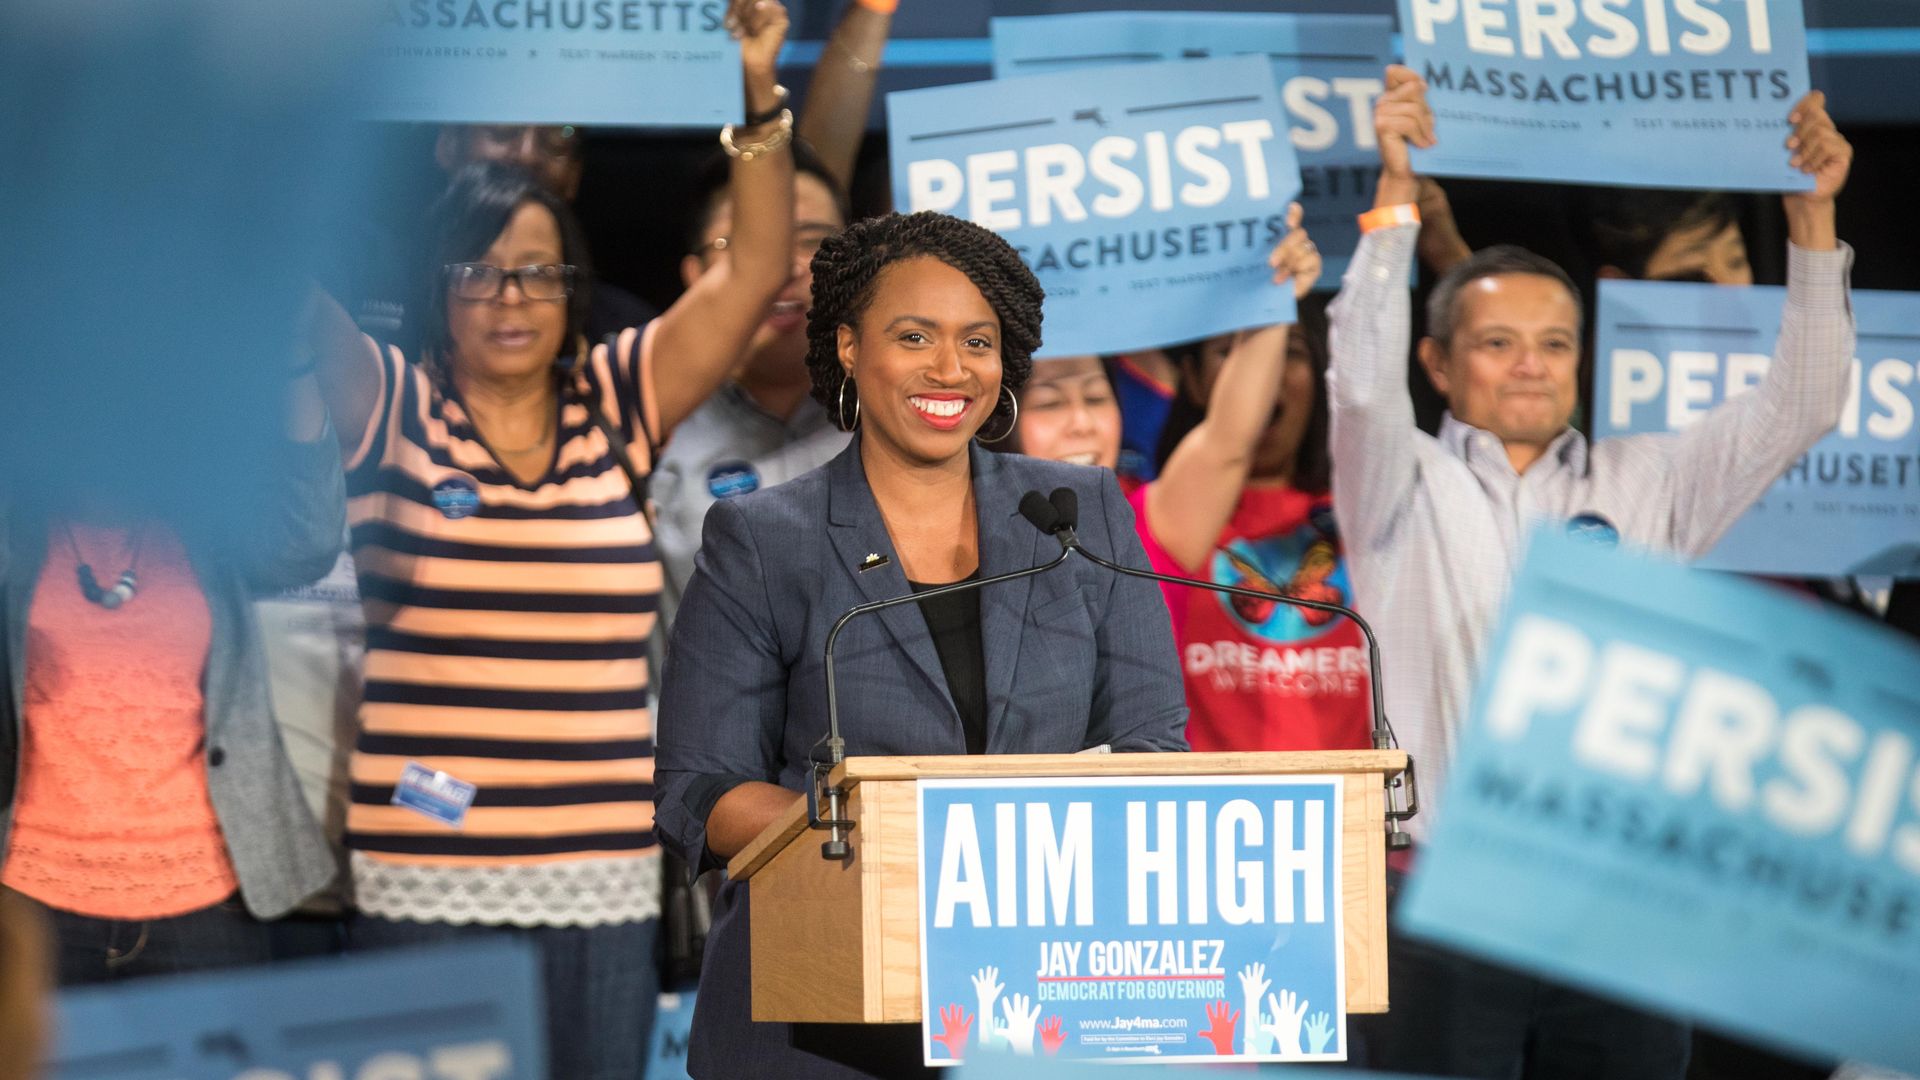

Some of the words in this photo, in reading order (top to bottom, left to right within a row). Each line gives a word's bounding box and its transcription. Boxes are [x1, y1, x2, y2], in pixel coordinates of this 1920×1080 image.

[382, 0, 724, 32] ASSACHUSETTS
[1425, 61, 1791, 103] MASSACHUSETTS
[907, 119, 1275, 230] PERSIST
[1018, 214, 1284, 272] SACHUSETTS
[1609, 348, 1920, 440] PEIS
[1486, 613, 1920, 874] PERSI
[934, 801, 1094, 928] AIM
[1127, 798, 1325, 926] HIGH
[1036, 941, 1083, 977] JAY
[1088, 939, 1225, 976] GONZALEZ
[1038, 981, 1116, 1001] DEMOCRAT
[1117, 981, 1146, 1000] FOR
[1147, 979, 1226, 1000] GOVERNOR
[1079, 1016, 1187, 1031] www.Jay4ma.com
